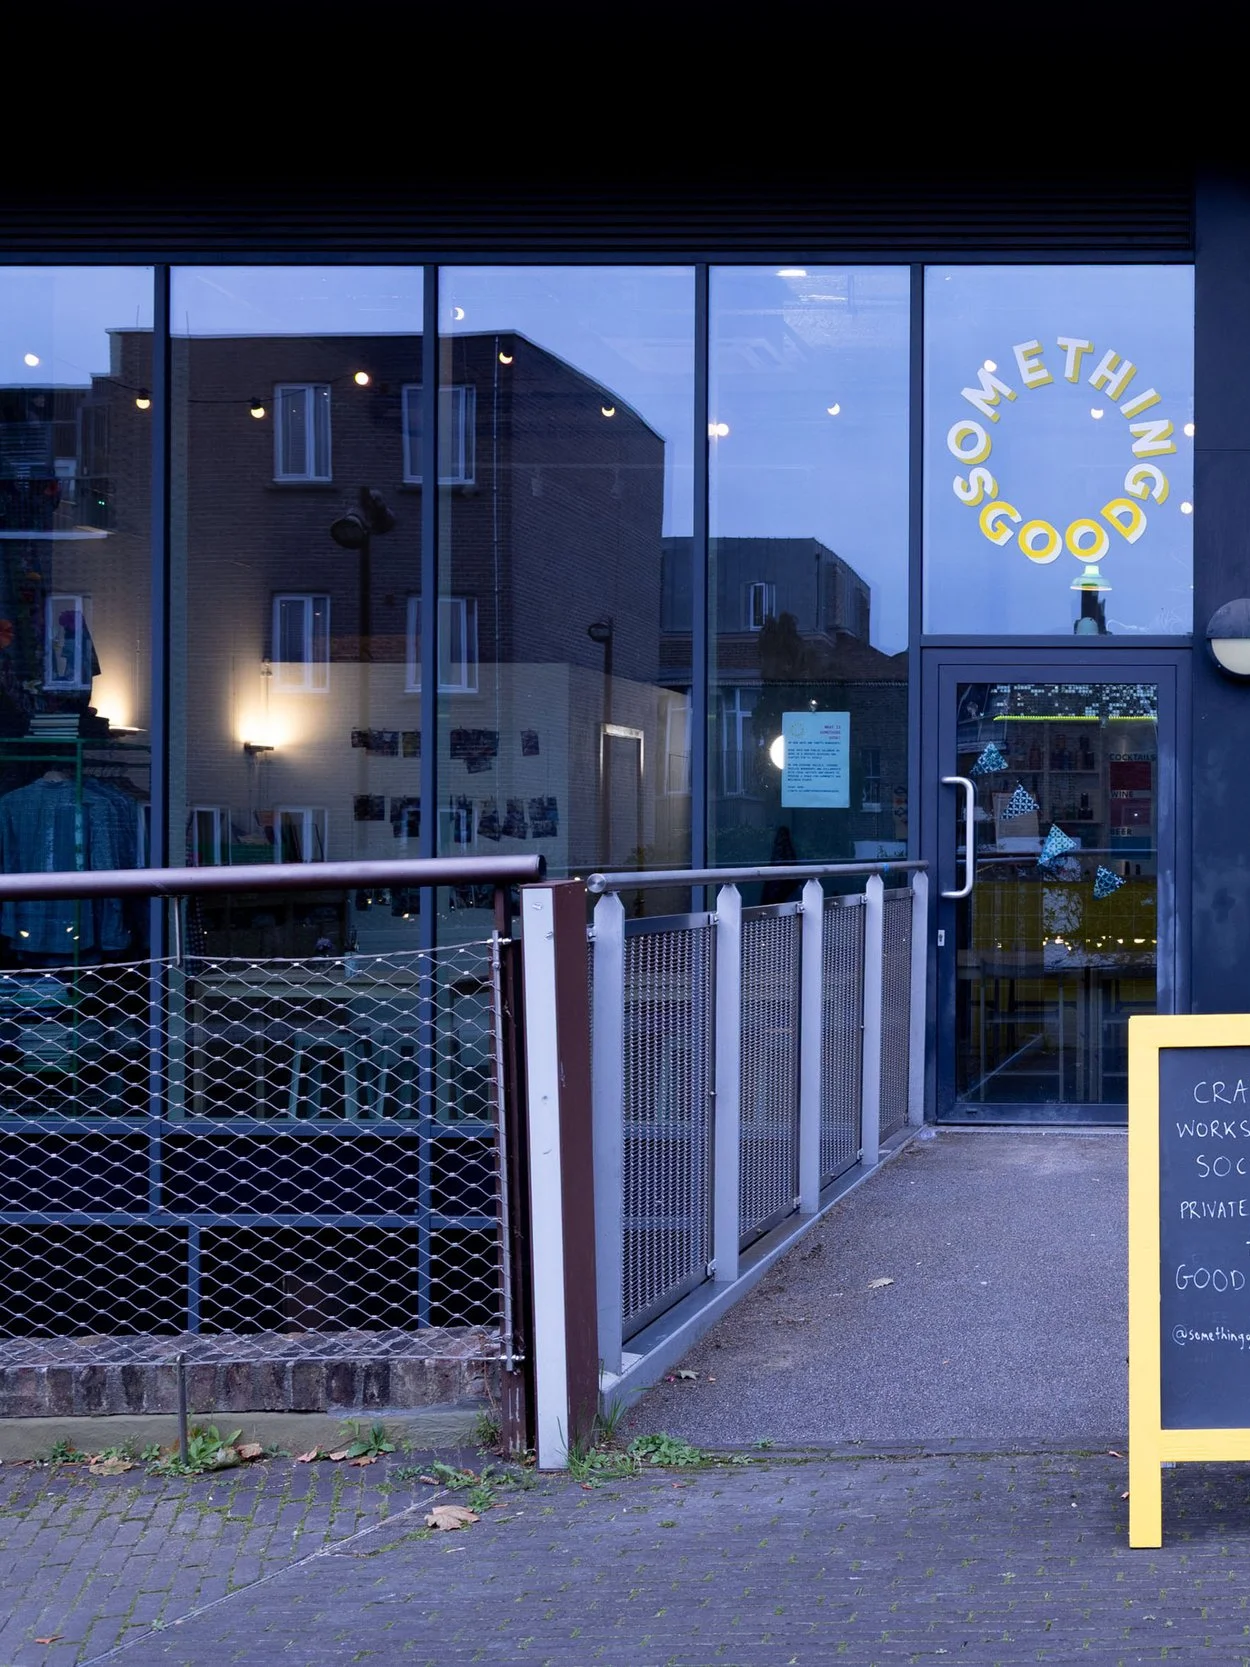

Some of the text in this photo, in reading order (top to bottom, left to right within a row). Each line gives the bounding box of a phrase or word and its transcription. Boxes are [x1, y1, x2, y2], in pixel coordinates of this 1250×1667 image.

[946, 336, 1178, 507] SOMETHING
[978, 497, 1148, 564] GOOD
[1109, 753, 1157, 762] COCKTAILS
[1111, 790, 1134, 799] WINE
[1110, 828, 1133, 837] BEER
[1180, 1200, 1248, 1219] PRIVATE
[1175, 1264, 1245, 1292] GOOD
